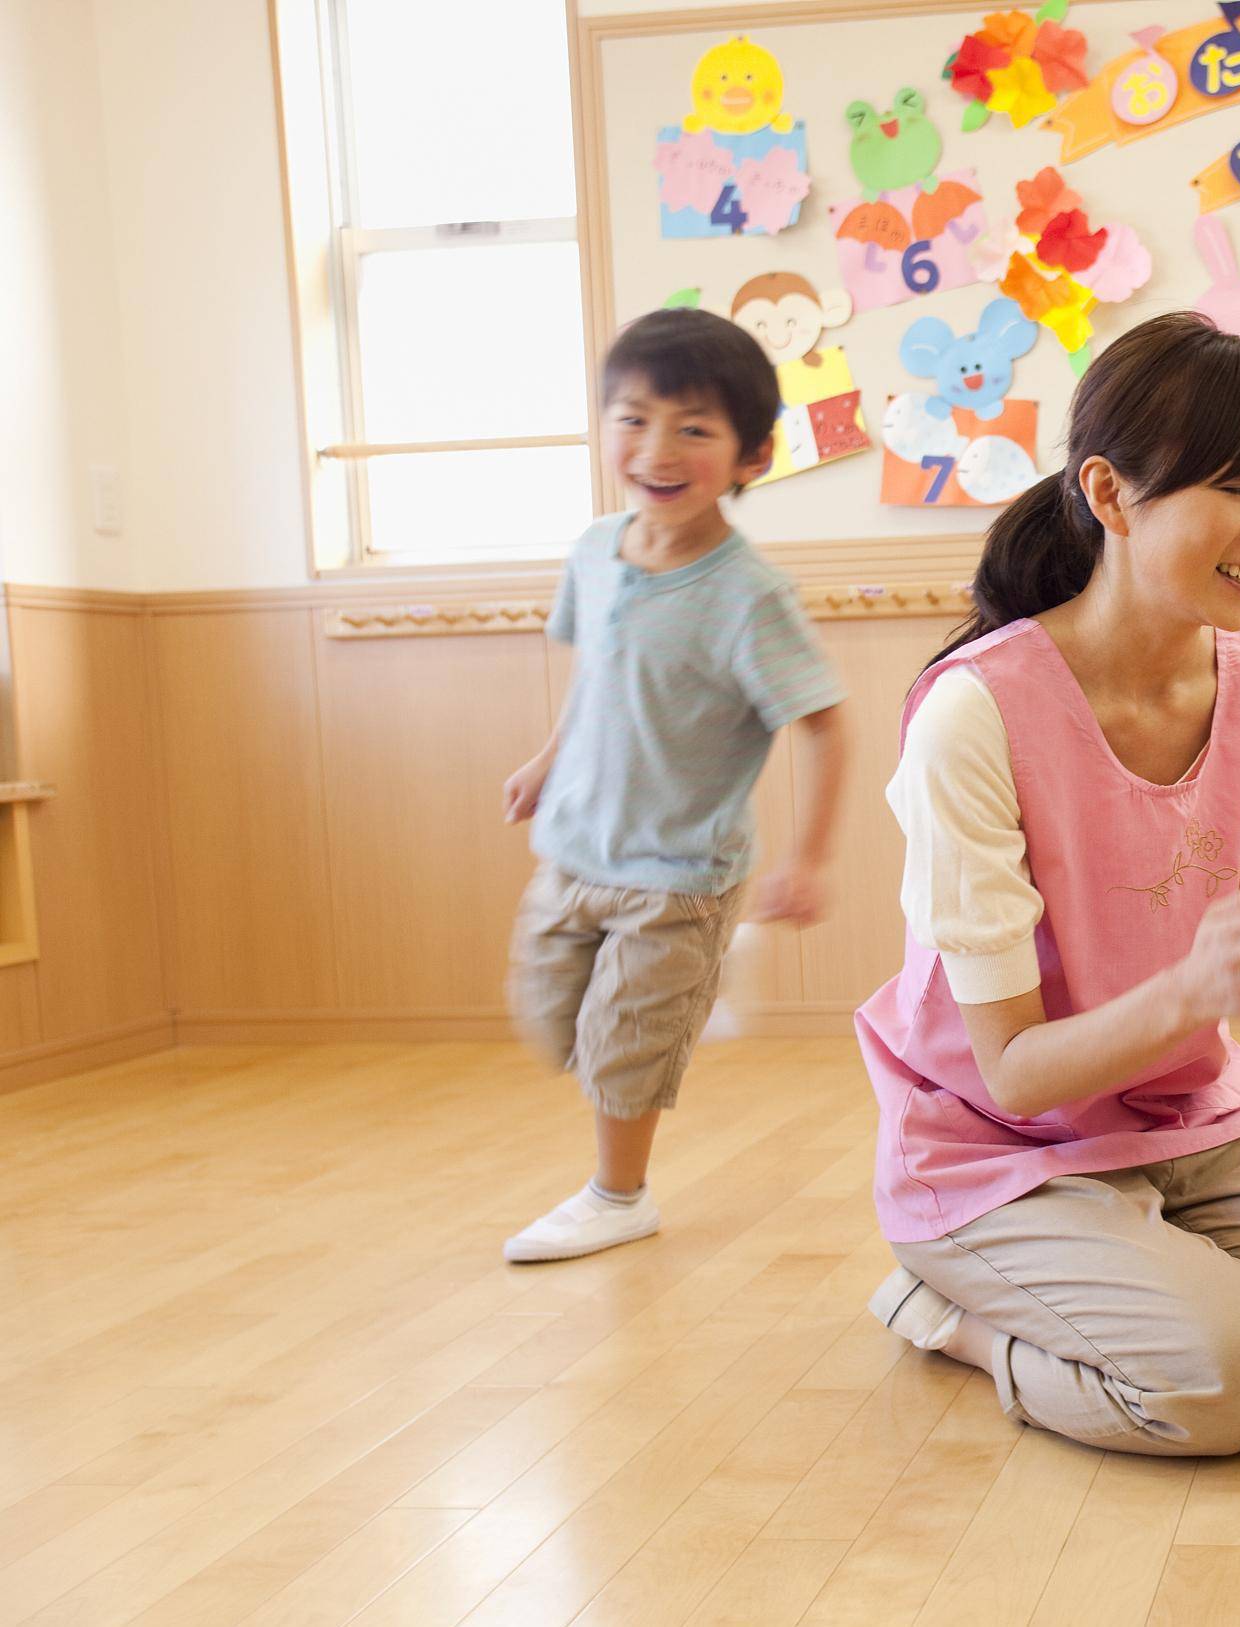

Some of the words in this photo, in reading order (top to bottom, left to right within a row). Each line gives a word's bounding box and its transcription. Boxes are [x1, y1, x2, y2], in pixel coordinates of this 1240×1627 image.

[710, 184, 749, 234] 4
[901, 239, 941, 294] 6
[920, 455, 955, 504] 7
